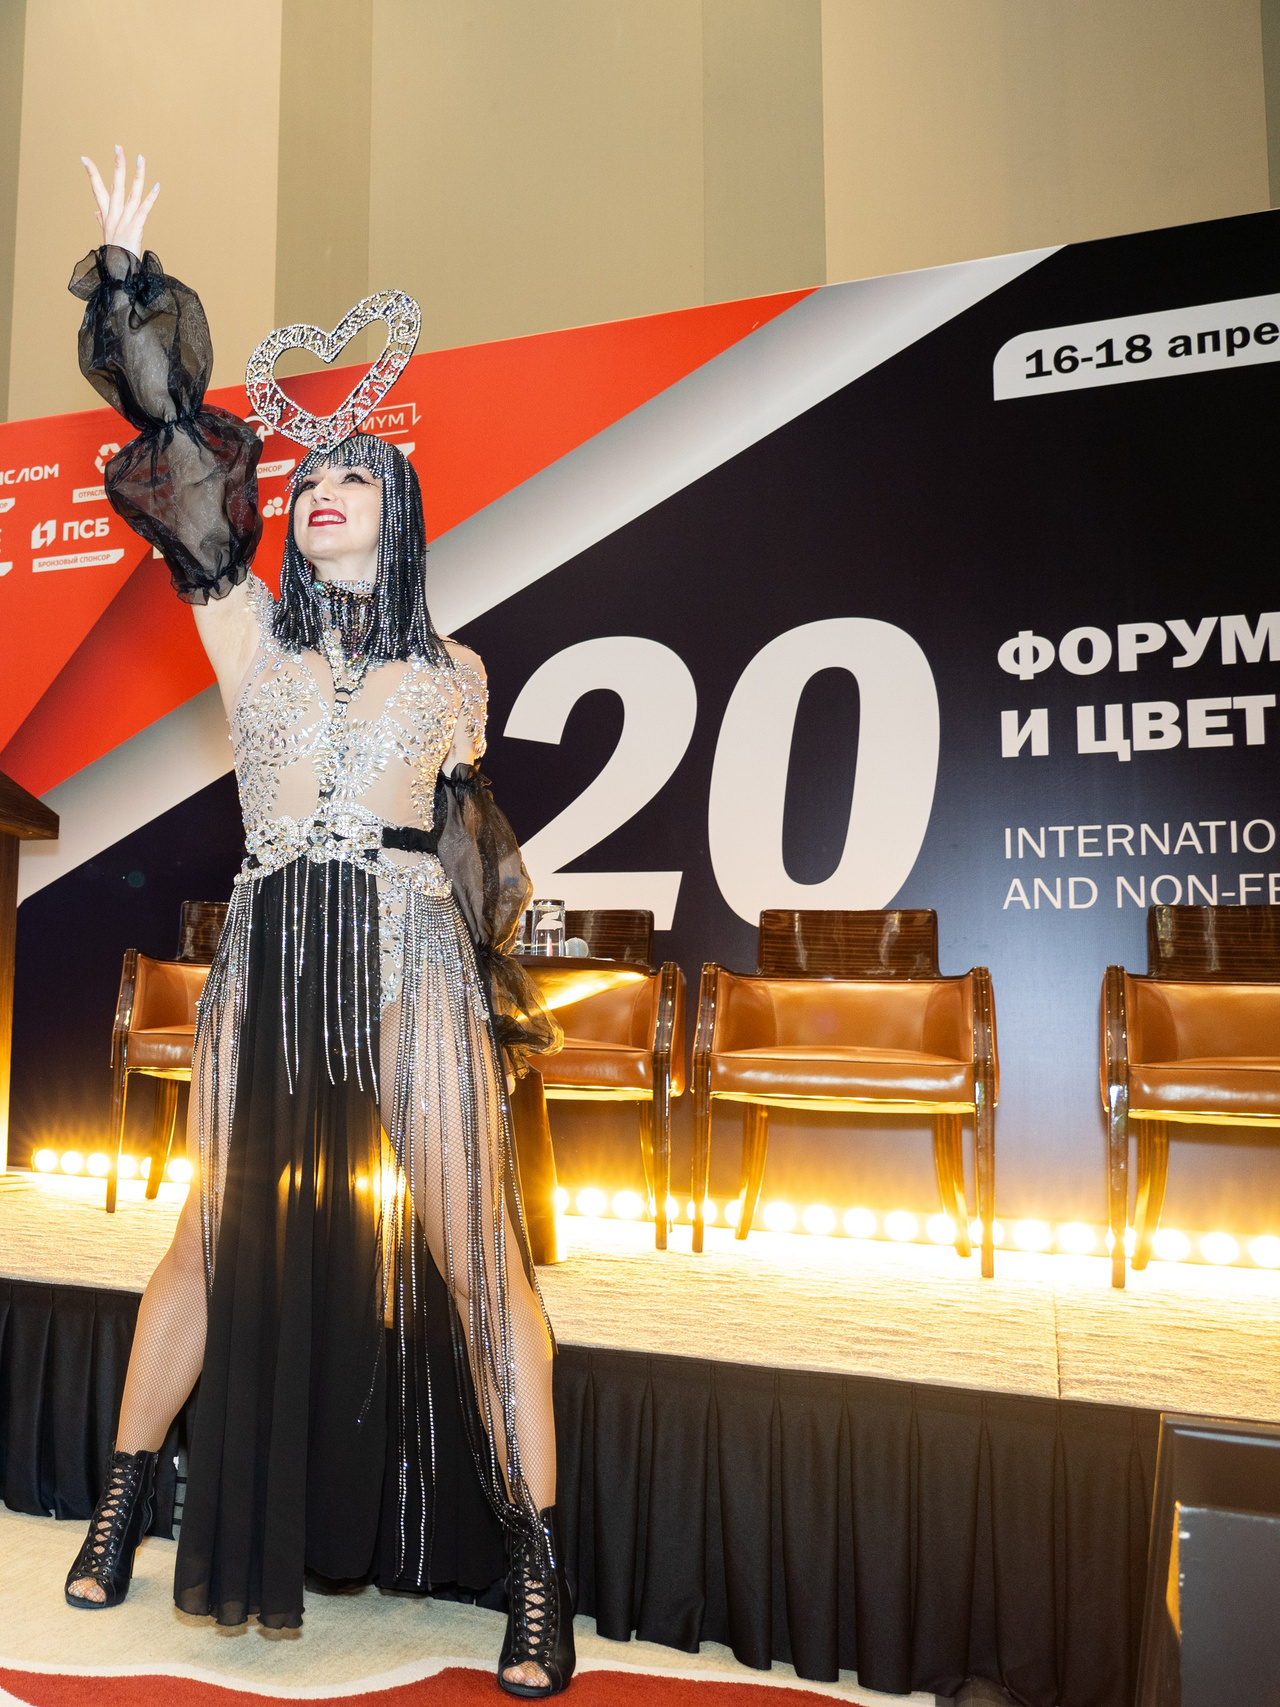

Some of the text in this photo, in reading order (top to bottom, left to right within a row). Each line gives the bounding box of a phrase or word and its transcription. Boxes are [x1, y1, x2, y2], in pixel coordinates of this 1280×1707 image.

[1025, 322, 1280, 379] 16-18 апре
[63, 517, 110, 542] ПСБ
[38, 553, 110, 569] БРОНЗОВЫЙ СПОНСОР
[997, 611, 1280, 681] ФОРУМ
[1001, 694, 1277, 762] И ЦВЕТ
[503, 617, 940, 931] 20
[1004, 818, 1277, 859] INTERNATIO
[1002, 876, 1099, 910] AND
